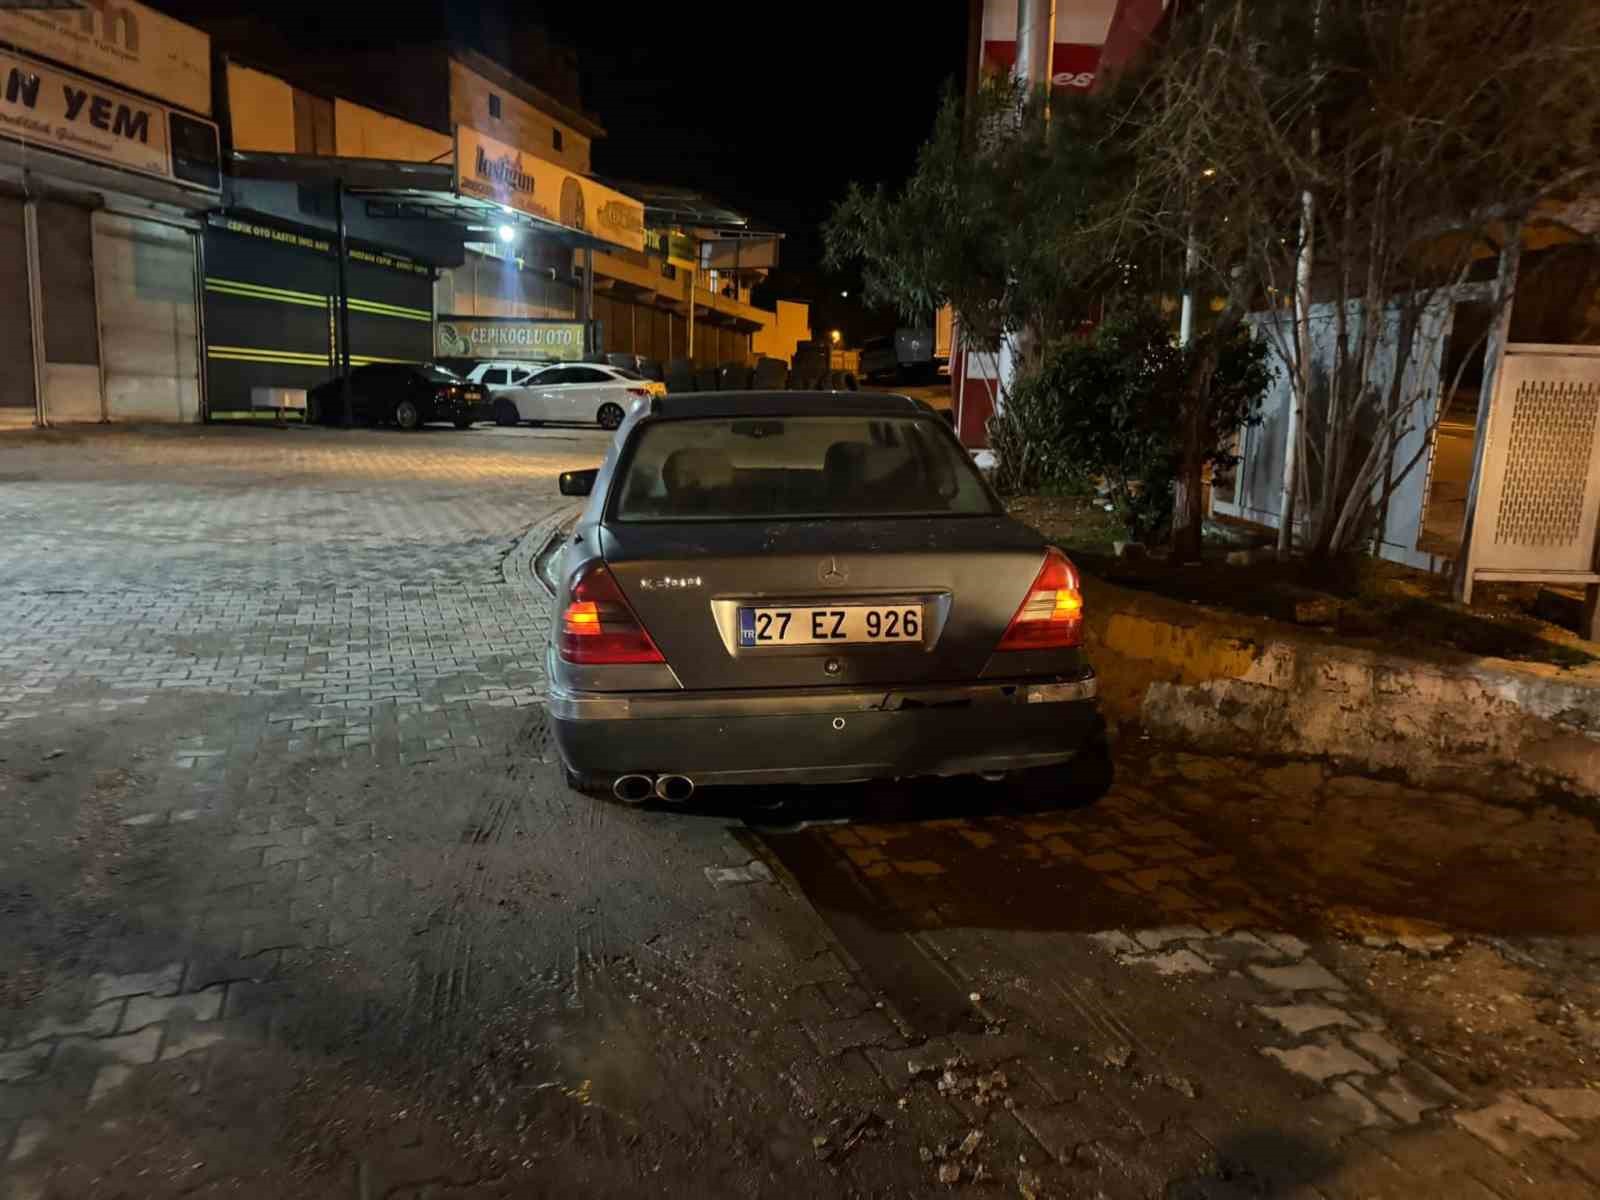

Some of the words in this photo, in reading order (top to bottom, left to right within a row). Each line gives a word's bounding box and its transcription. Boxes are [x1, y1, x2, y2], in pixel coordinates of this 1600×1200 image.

[0, 68, 41, 109] N
[62, 84, 150, 145] YEM
[253, 225, 271, 239] OTO
[546, 328, 573, 346] OTO
[743, 629, 755, 640] TR
[756, 611, 792, 641] 27
[811, 610, 847, 639] EZ
[866, 609, 919, 638] 926
